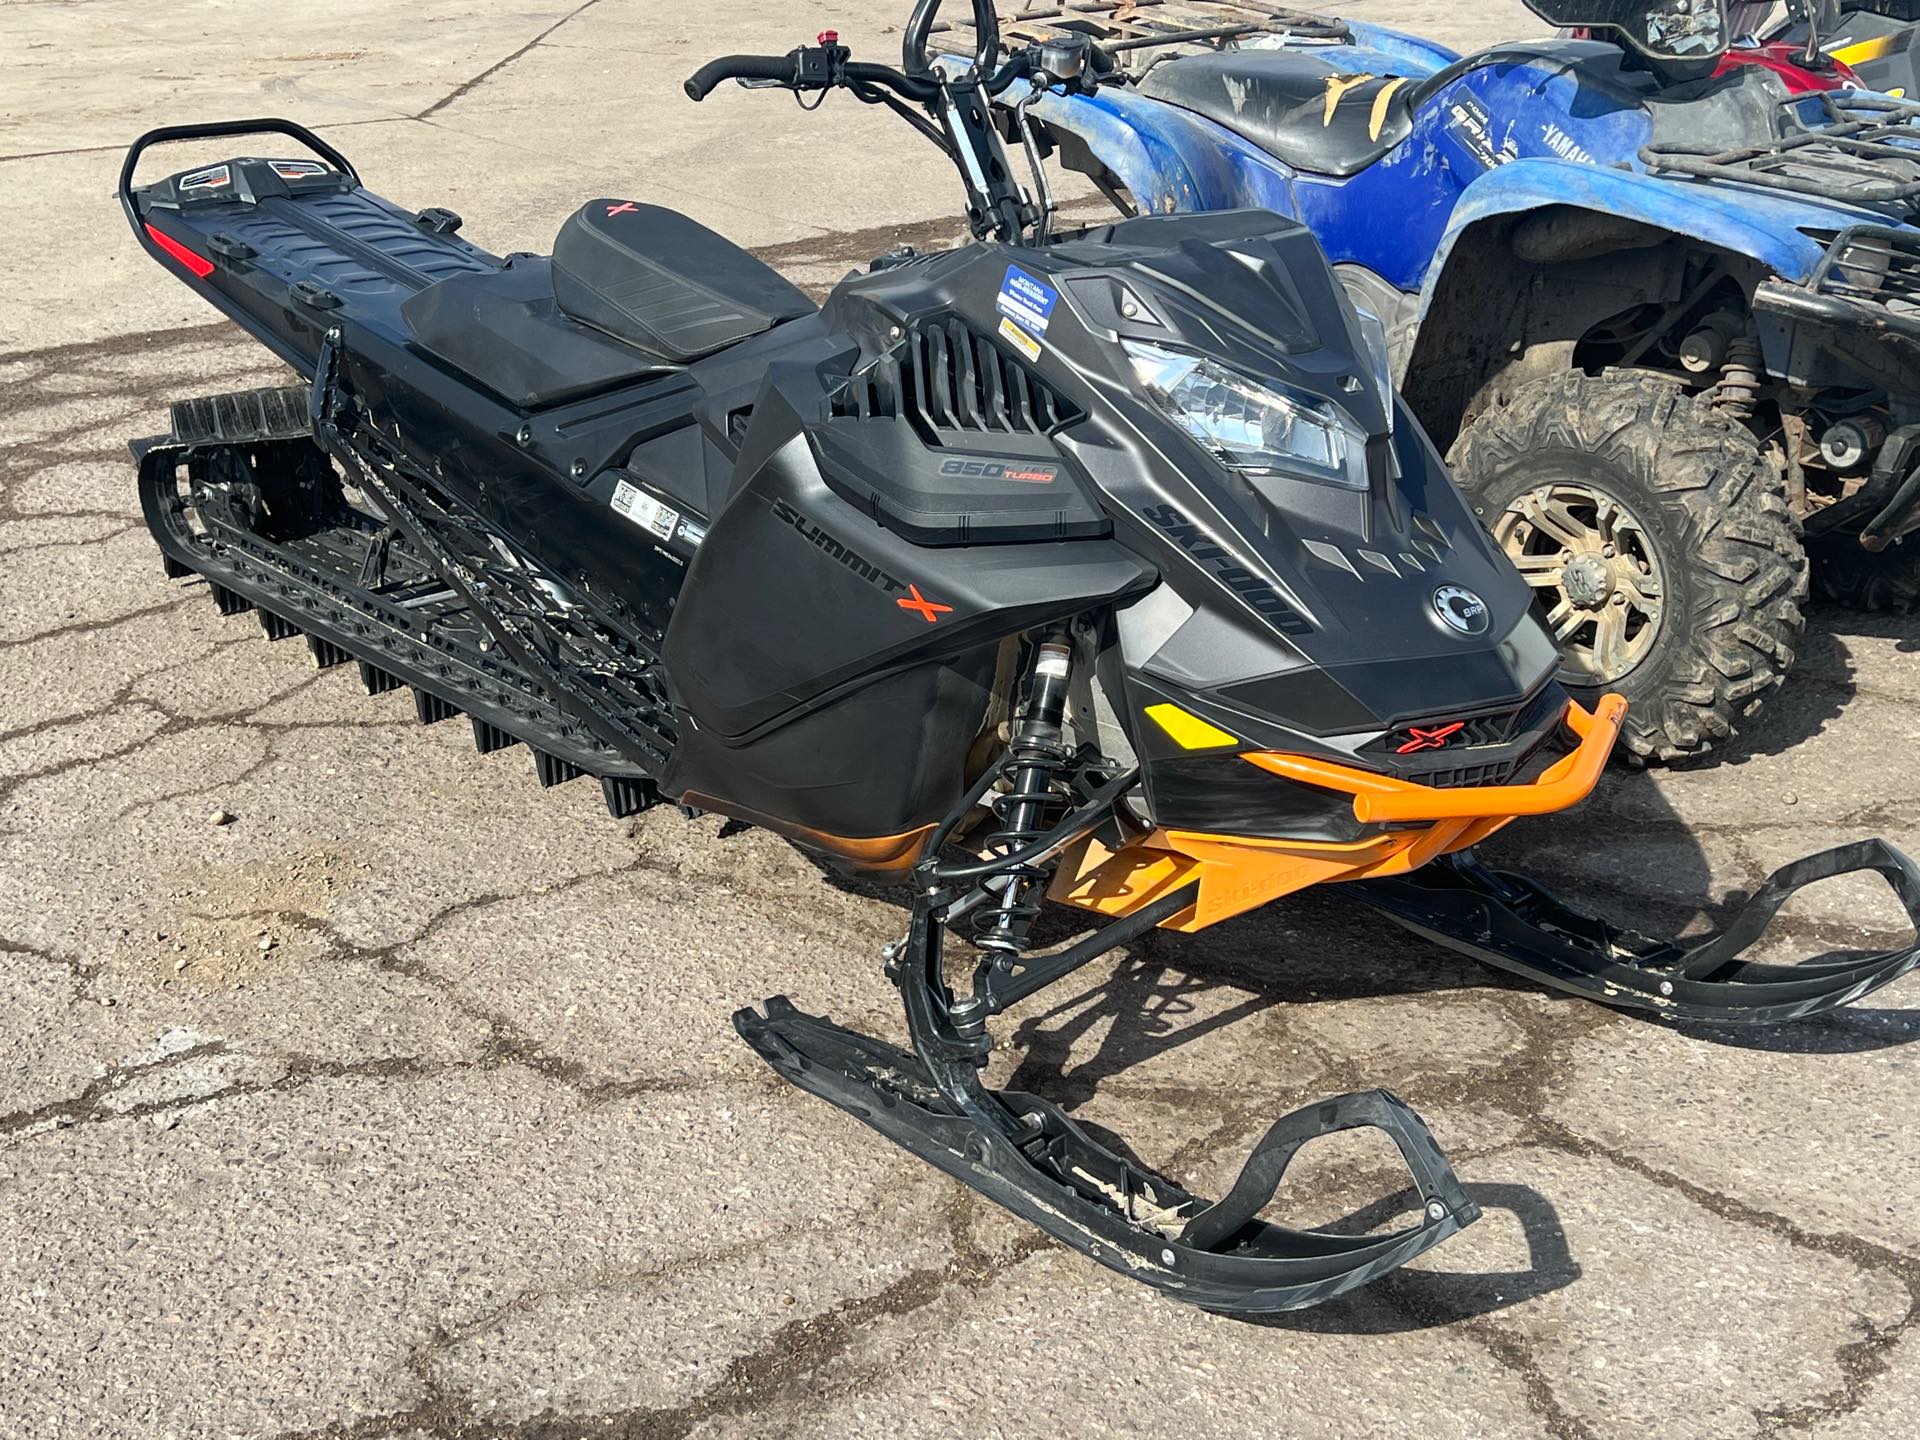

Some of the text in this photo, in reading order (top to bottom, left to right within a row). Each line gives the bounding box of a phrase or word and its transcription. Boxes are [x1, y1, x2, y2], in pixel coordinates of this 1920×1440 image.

[1541, 122, 1597, 165] YAMAH
[941, 460, 1006, 478] 850
[1004, 471, 1054, 482] TURBO
[771, 498, 906, 593] SUMMIT
[896, 584, 955, 623] X
[1142, 504, 1314, 636] SKI-DOO
[1462, 605, 1484, 618] BRP
